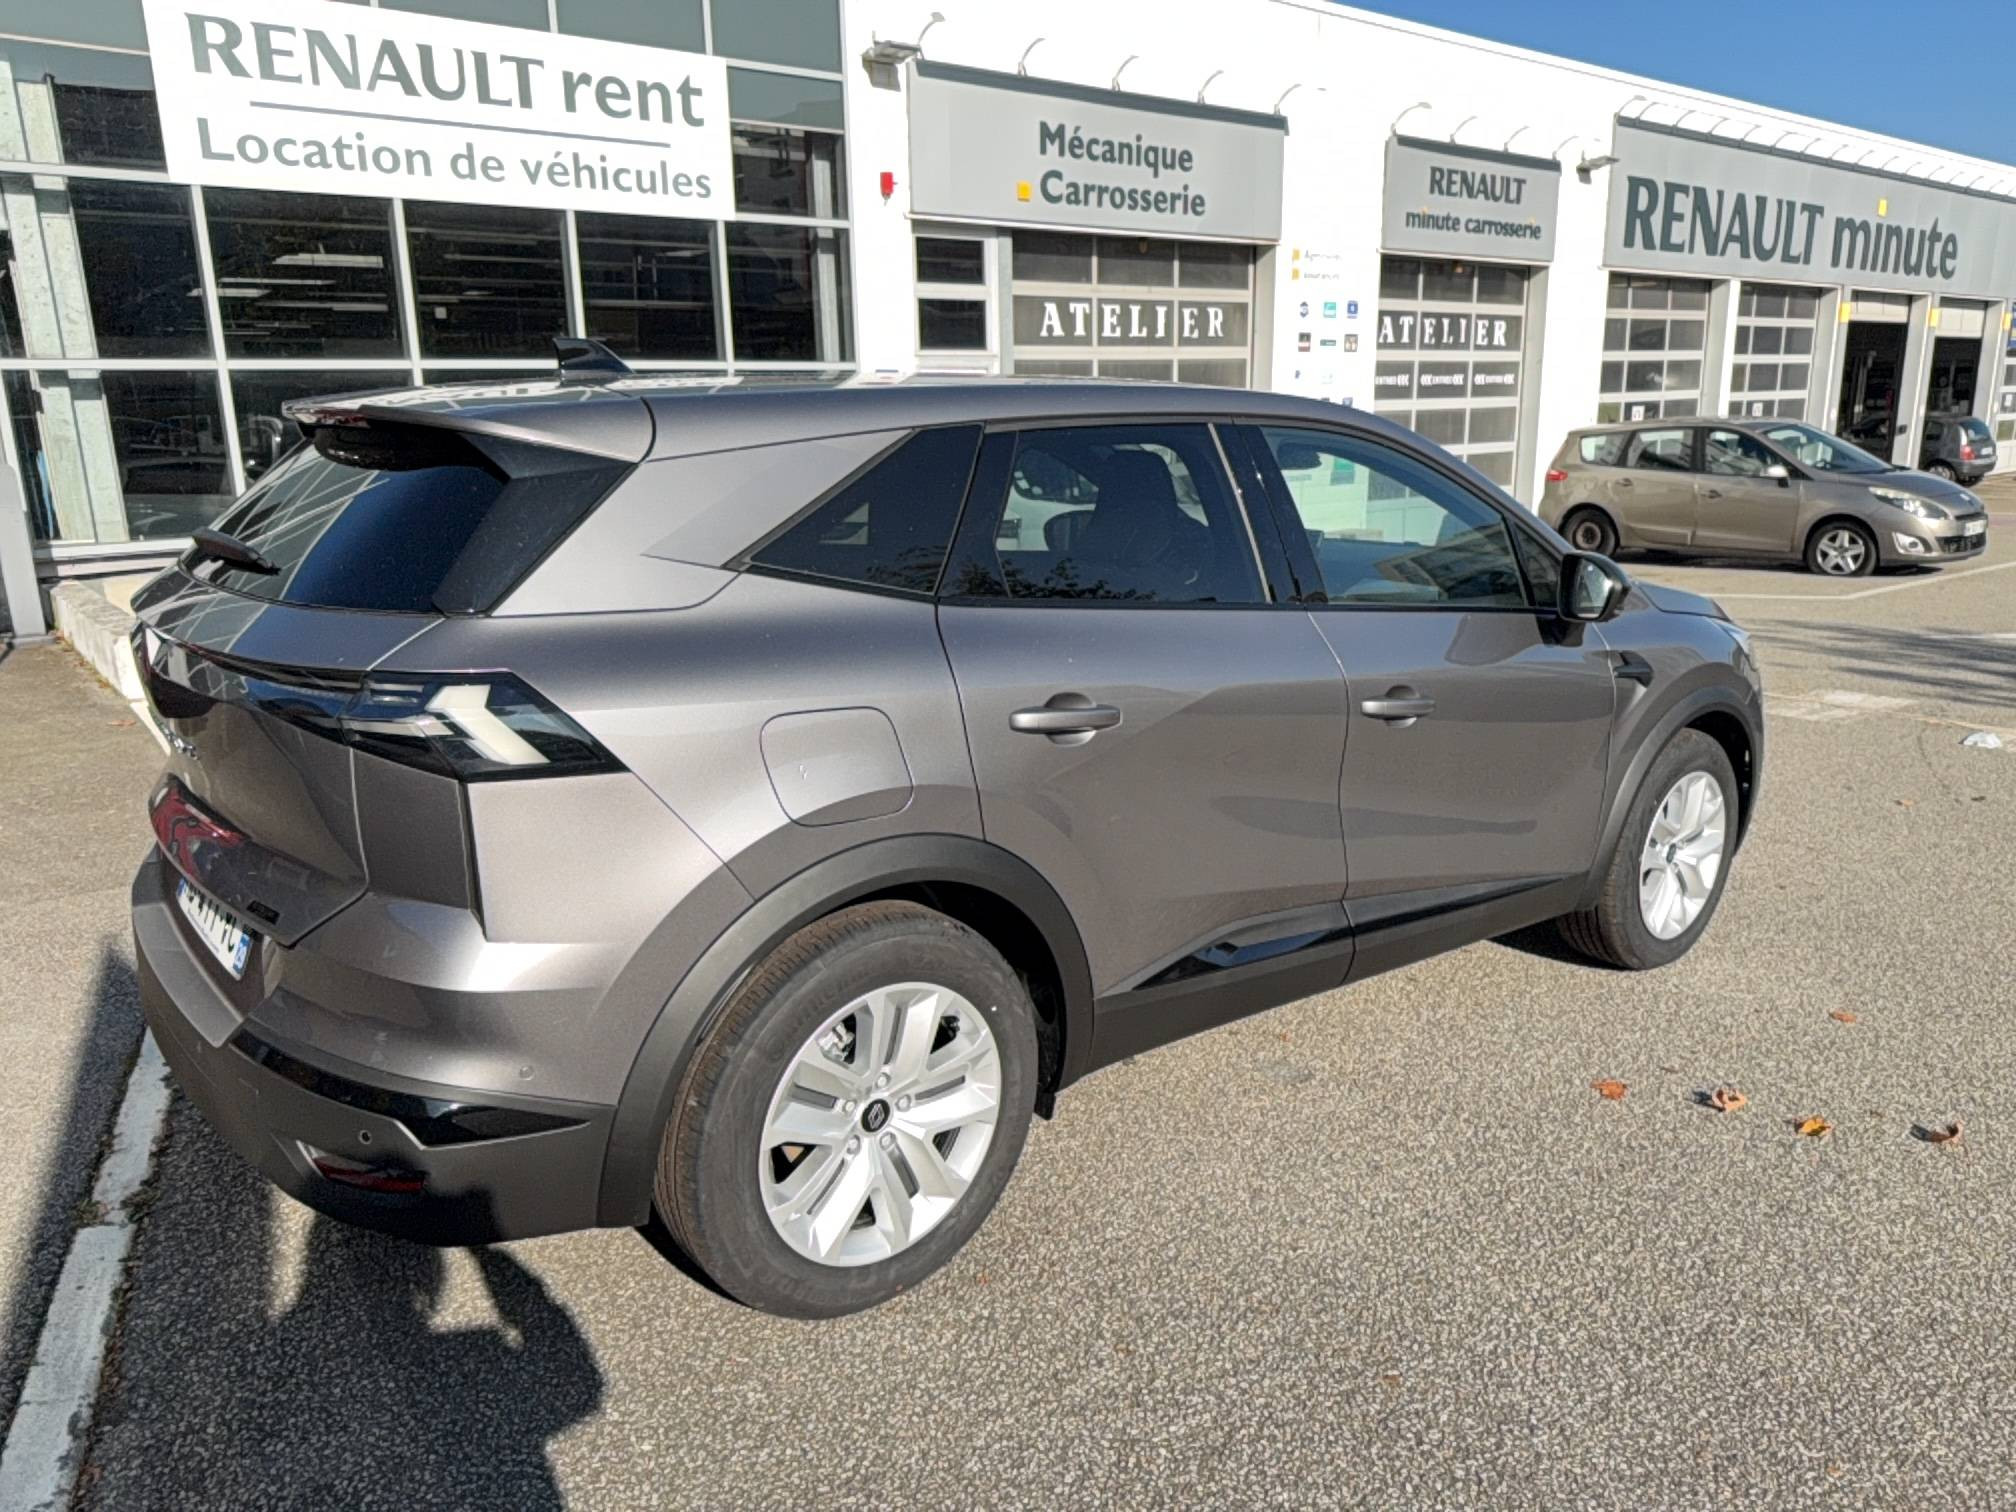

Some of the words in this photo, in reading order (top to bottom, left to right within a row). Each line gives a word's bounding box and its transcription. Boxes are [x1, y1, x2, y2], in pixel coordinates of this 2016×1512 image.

[184, 11, 545, 109] RENAULT
[562, 68, 706, 128] rent
[196, 117, 433, 177] Location
[450, 142, 505, 182] de
[520, 148, 712, 199] véhicules
[1039, 120, 1194, 178] Mécanique
[1039, 169, 1206, 216] Carrosserie
[1429, 165, 1527, 205] RENAULT
[1405, 207, 1461, 233] minute
[1464, 215, 1542, 240] carrosserie
[1623, 175, 1825, 266] RENAULT
[1830, 198, 1959, 280] minute
[1039, 302, 1225, 339] ATELIER
[1378, 315, 1508, 347] ATELIER
